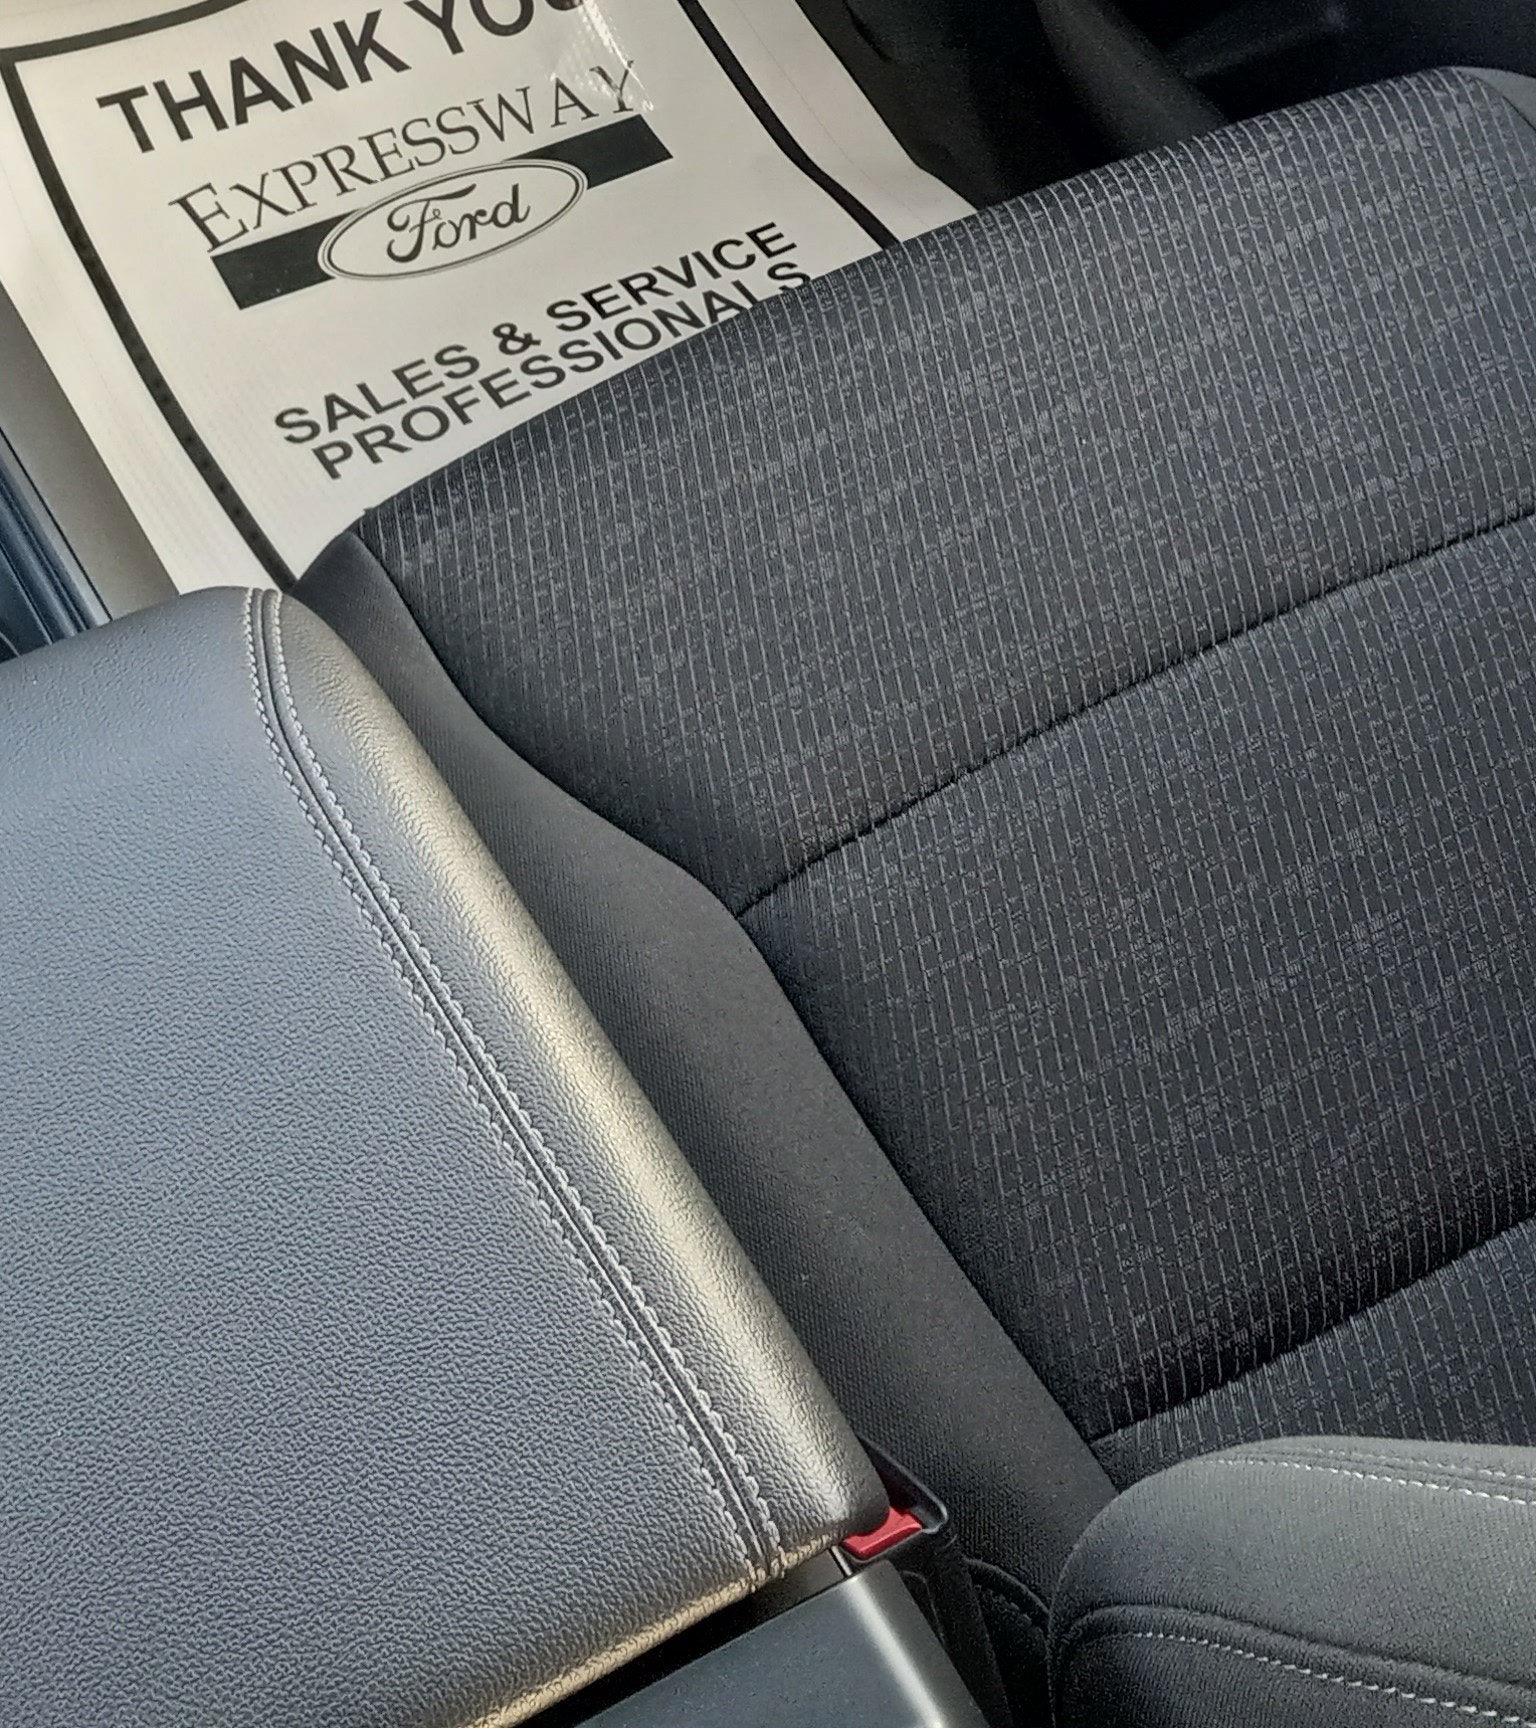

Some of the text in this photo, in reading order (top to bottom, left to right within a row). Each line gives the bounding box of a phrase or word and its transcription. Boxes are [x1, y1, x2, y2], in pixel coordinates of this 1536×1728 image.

[95, 8, 412, 154] THANK
[167, 59, 638, 253] EXPRESSWAY
[384, 182, 531, 264] Ford
[274, 221, 798, 446] SALES & SERVICE
[311, 261, 811, 481] PROFESSIONALS
